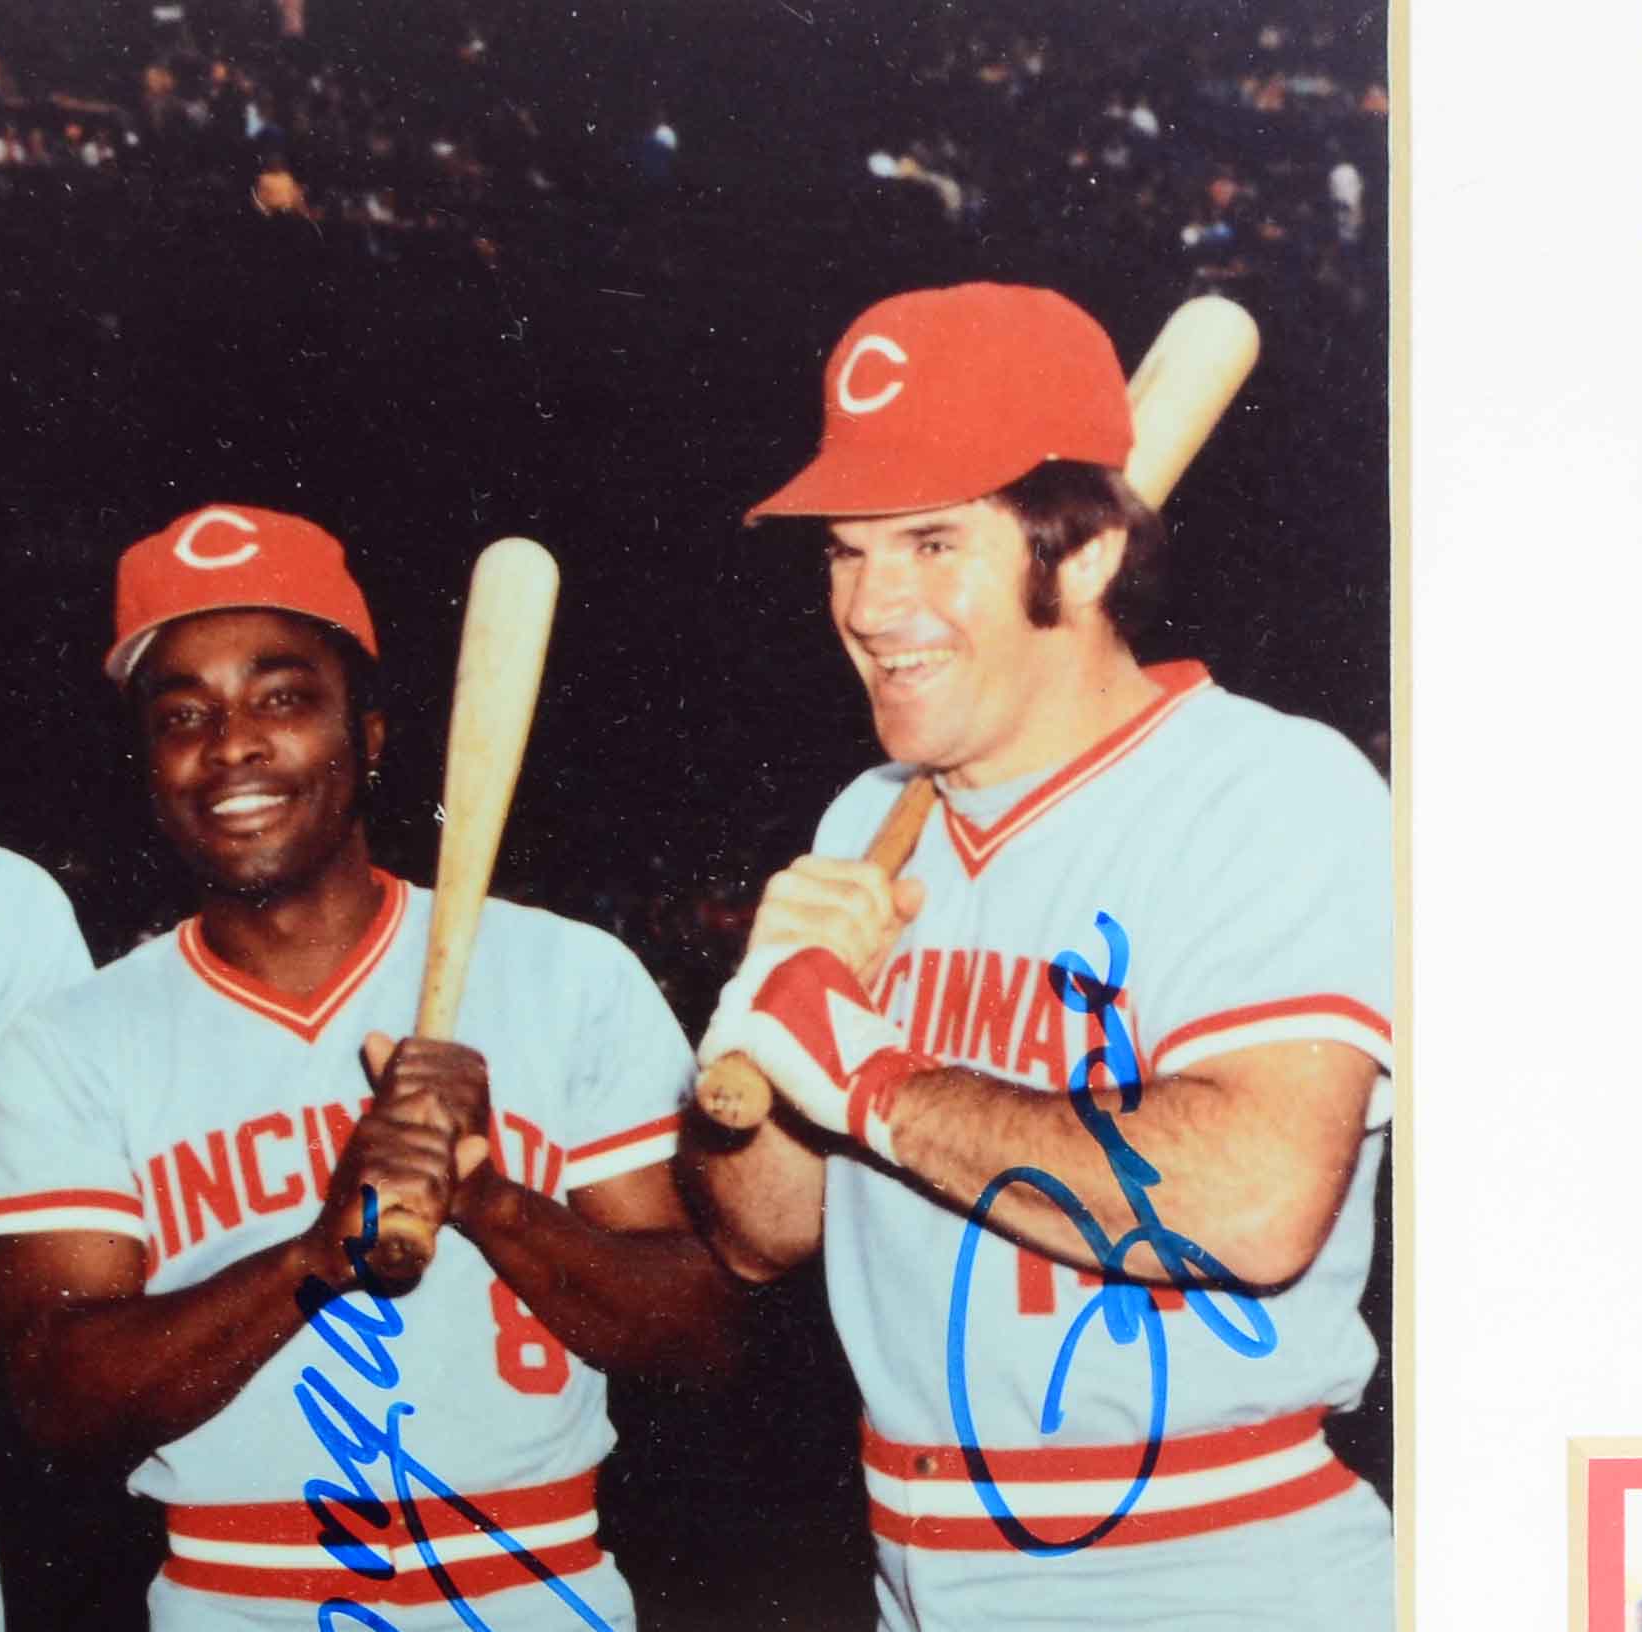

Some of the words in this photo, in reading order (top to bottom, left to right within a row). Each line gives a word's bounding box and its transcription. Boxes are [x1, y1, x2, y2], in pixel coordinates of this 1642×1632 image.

[837, 333, 907, 414] C
[173, 509, 261, 571] C
[489, 1277, 571, 1395] 8
